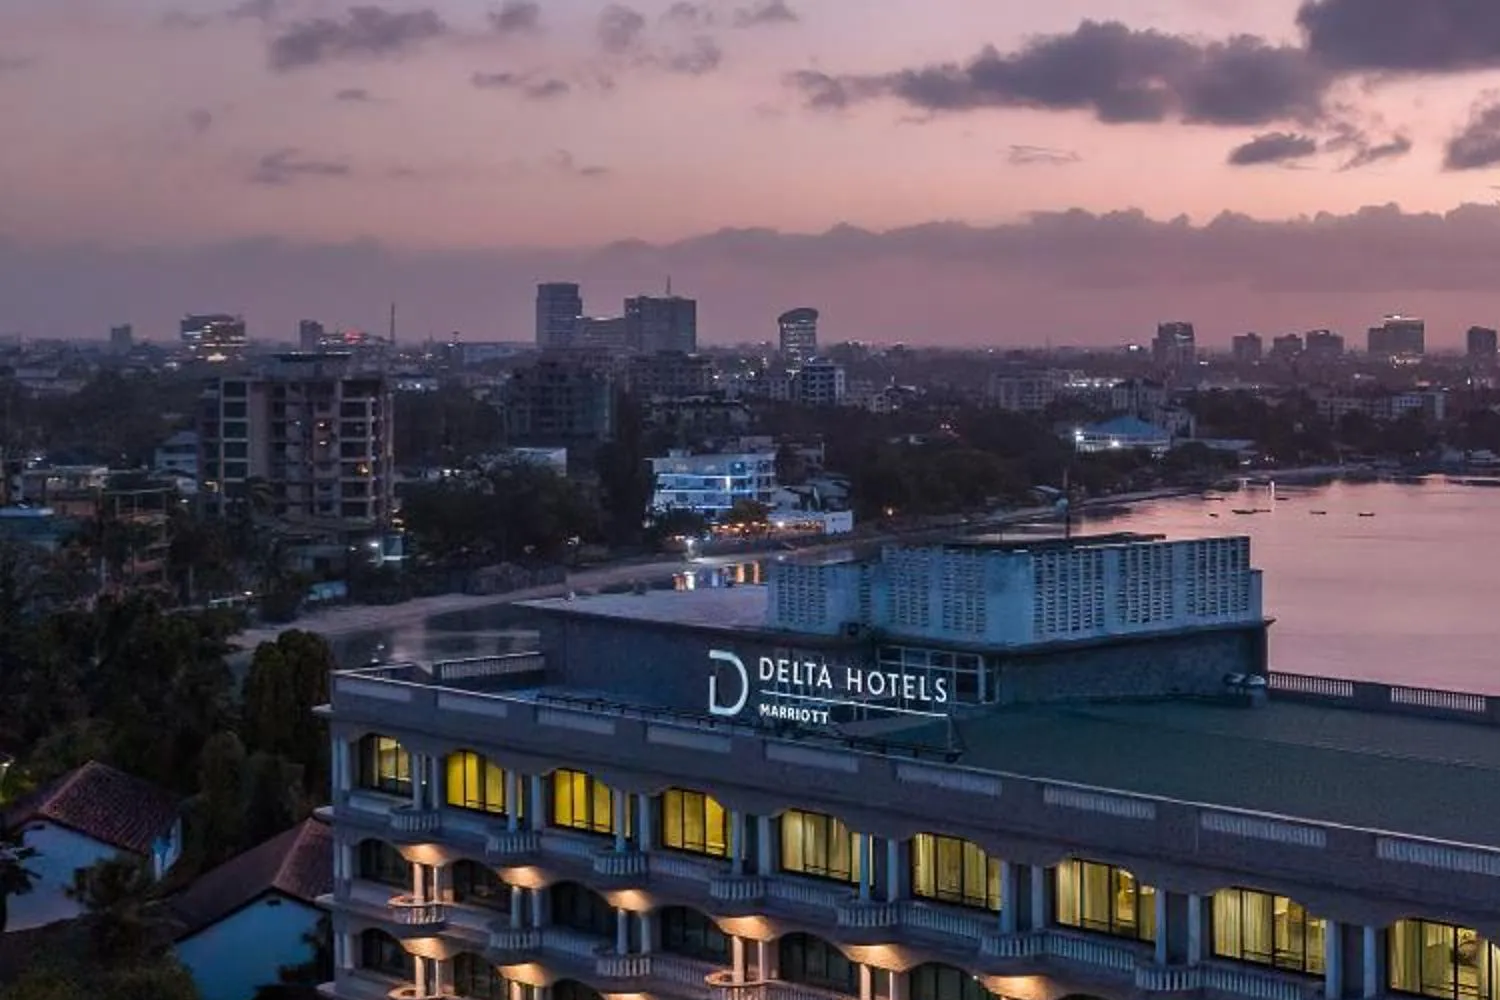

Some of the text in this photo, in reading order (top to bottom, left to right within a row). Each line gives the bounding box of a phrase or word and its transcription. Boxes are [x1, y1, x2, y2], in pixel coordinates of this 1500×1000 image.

[759, 657, 947, 702] DELTA HOTELS
[759, 703, 829, 725] MARRIOTT
